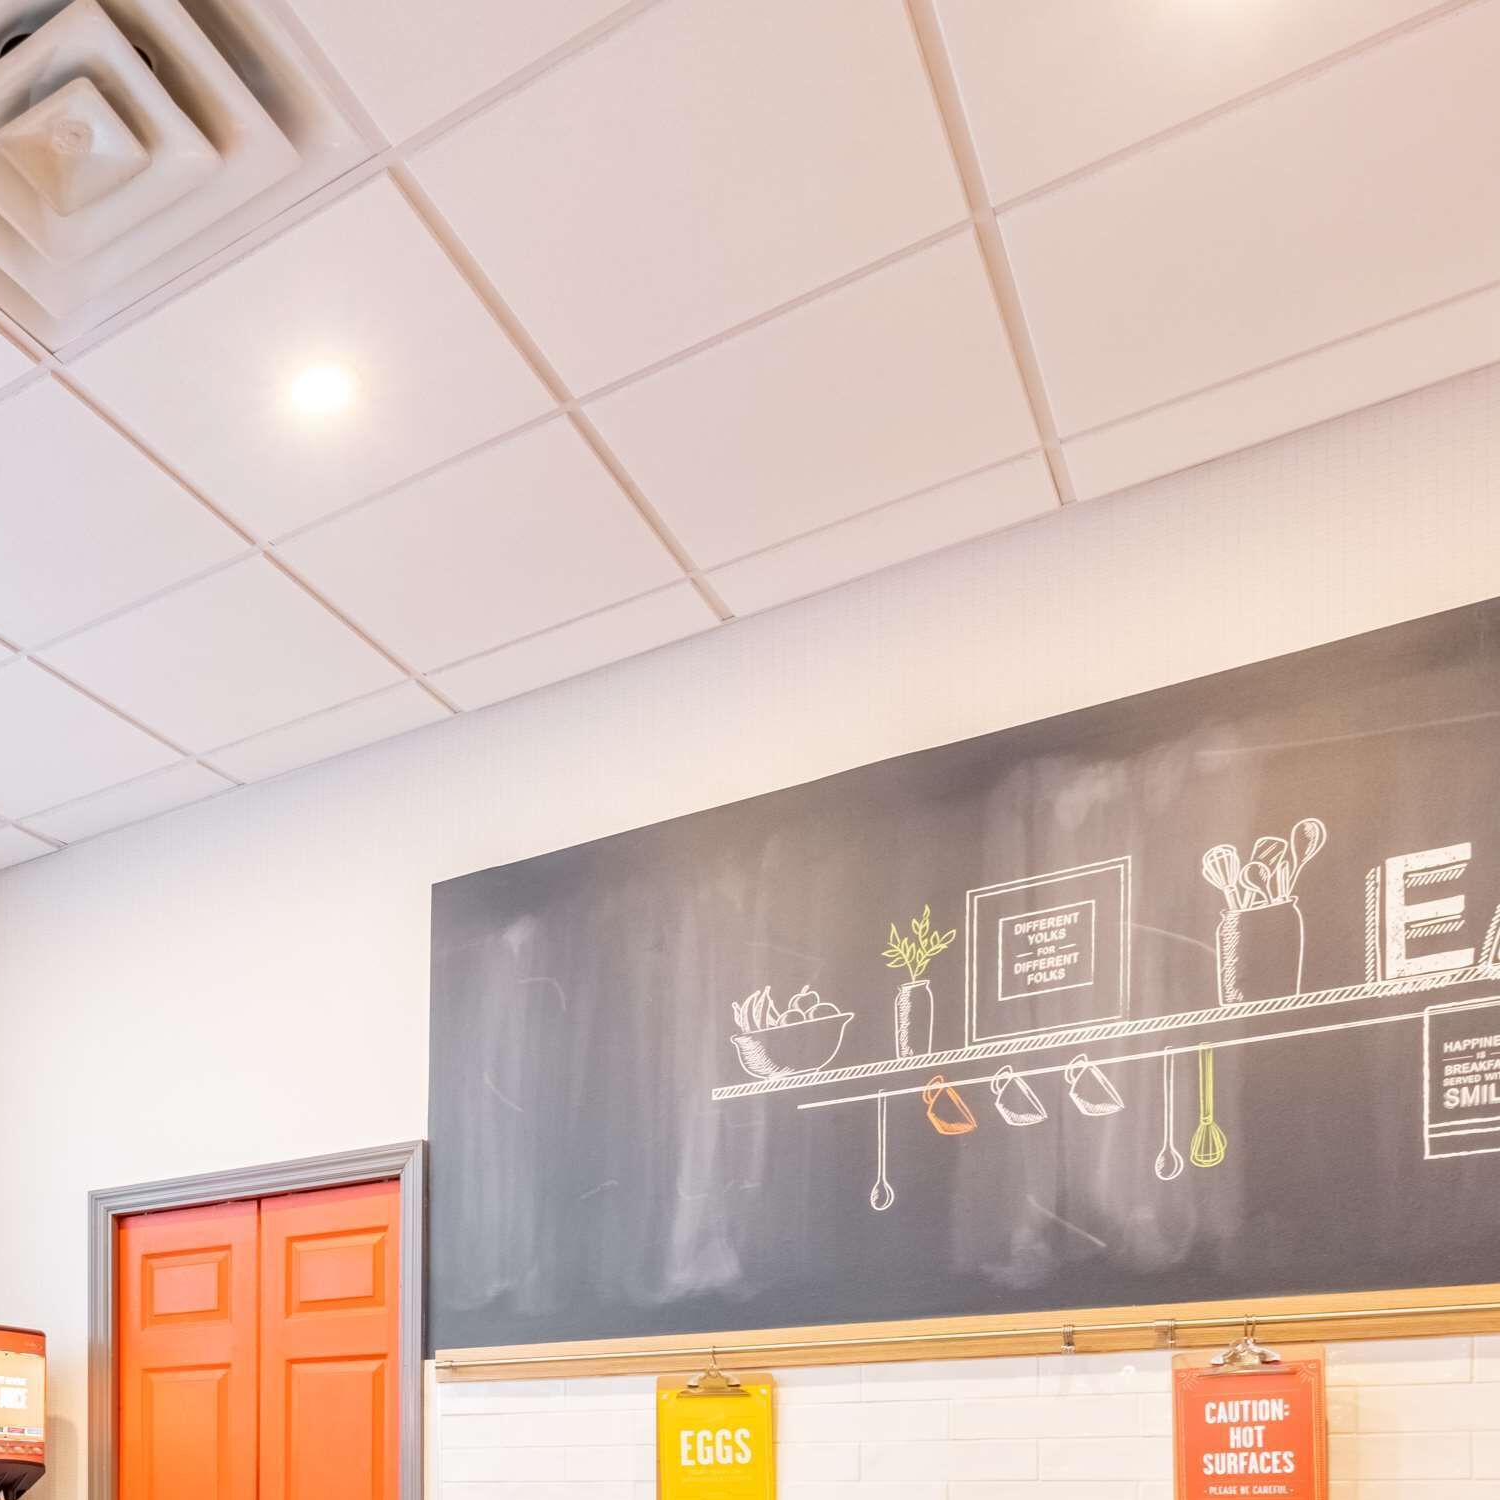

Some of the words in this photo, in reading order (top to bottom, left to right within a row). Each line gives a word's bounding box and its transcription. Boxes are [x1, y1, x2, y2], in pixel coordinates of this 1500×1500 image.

[1014, 911, 1080, 935] DIFFERENT
[1027, 928, 1067, 945] YOLKS
[1014, 951, 1080, 975] DIFFERENT
[1037, 945, 1056, 957] FOR
[1026, 968, 1066, 985] FOLKS
[1442, 1074, 1481, 1087] SERVED
[1204, 1398, 1291, 1424] CAUTION:
[680, 1427, 752, 1467] EGGS
[1229, 1425, 1266, 1449] HOT
[1202, 1451, 1295, 1476] SURFACES
[1208, 1485, 1237, 1496] PLEASE
[1240, 1485, 1250, 1495] BE
[1252, 1484, 1289, 1495] CAREFUL
